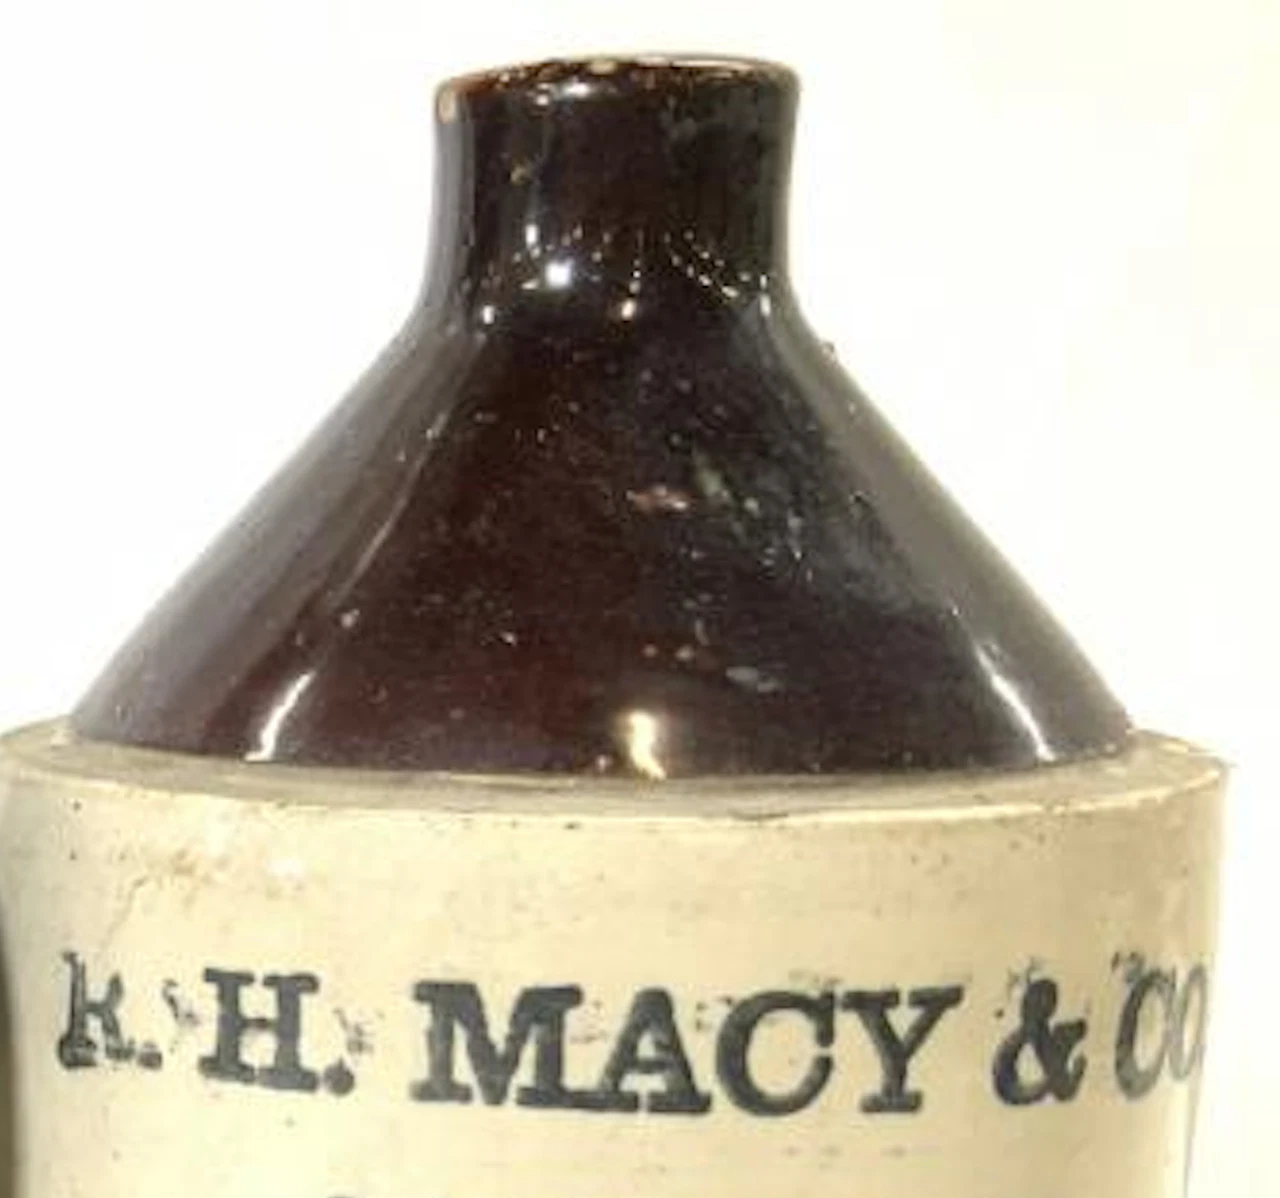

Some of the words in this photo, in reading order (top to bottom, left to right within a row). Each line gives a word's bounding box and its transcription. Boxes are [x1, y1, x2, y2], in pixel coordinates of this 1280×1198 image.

[198, 968, 355, 1096] H.
[411, 980, 962, 1117] MACY
[993, 978, 1087, 1105] &
